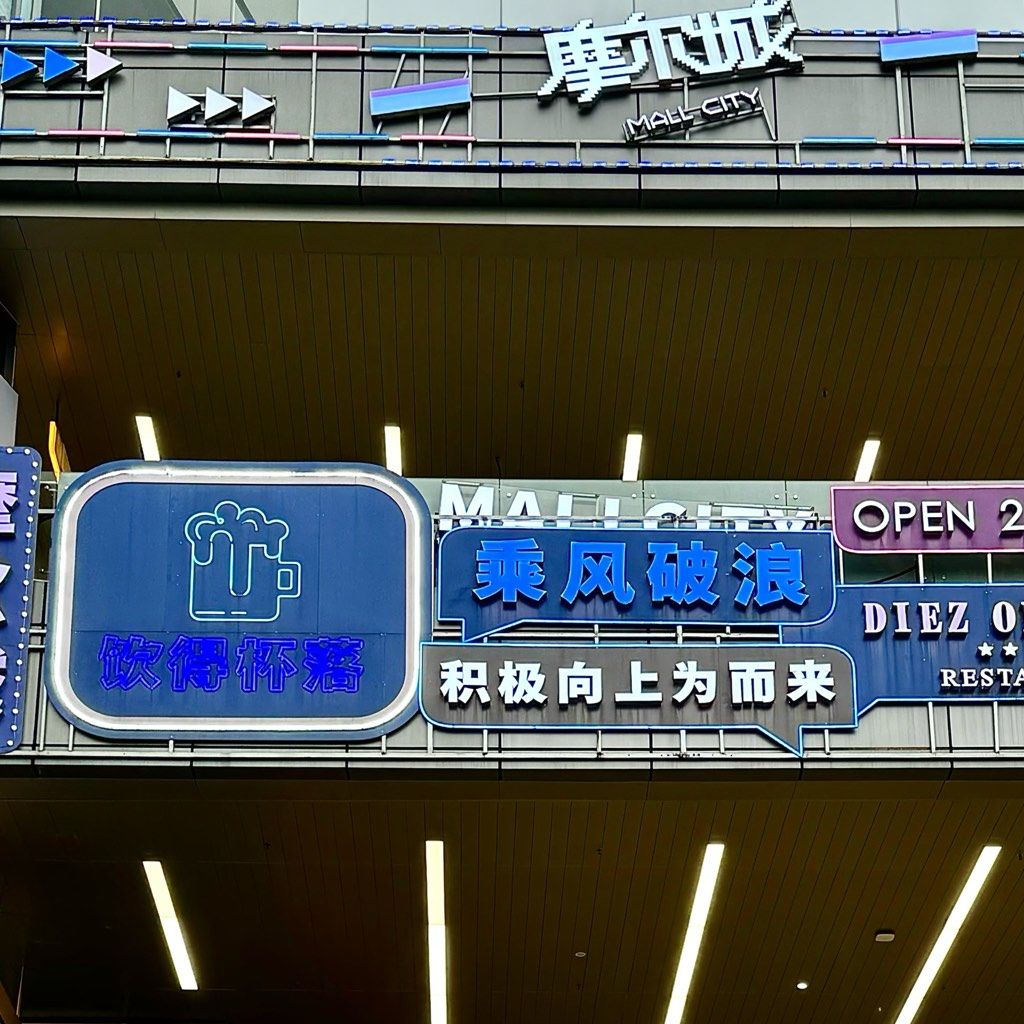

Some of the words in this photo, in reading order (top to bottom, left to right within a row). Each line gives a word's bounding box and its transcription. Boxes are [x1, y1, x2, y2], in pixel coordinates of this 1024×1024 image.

[624, 105, 694, 140] MALL
[700, 87, 761, 119] CITY
[853, 500, 975, 532] OPEN
[472, 538, 810, 607] 乘风破浪
[863, 602, 970, 634] DIEZ
[98, 635, 364, 694] 饮得杯落
[439, 659, 836, 706] 积极向上为而来
